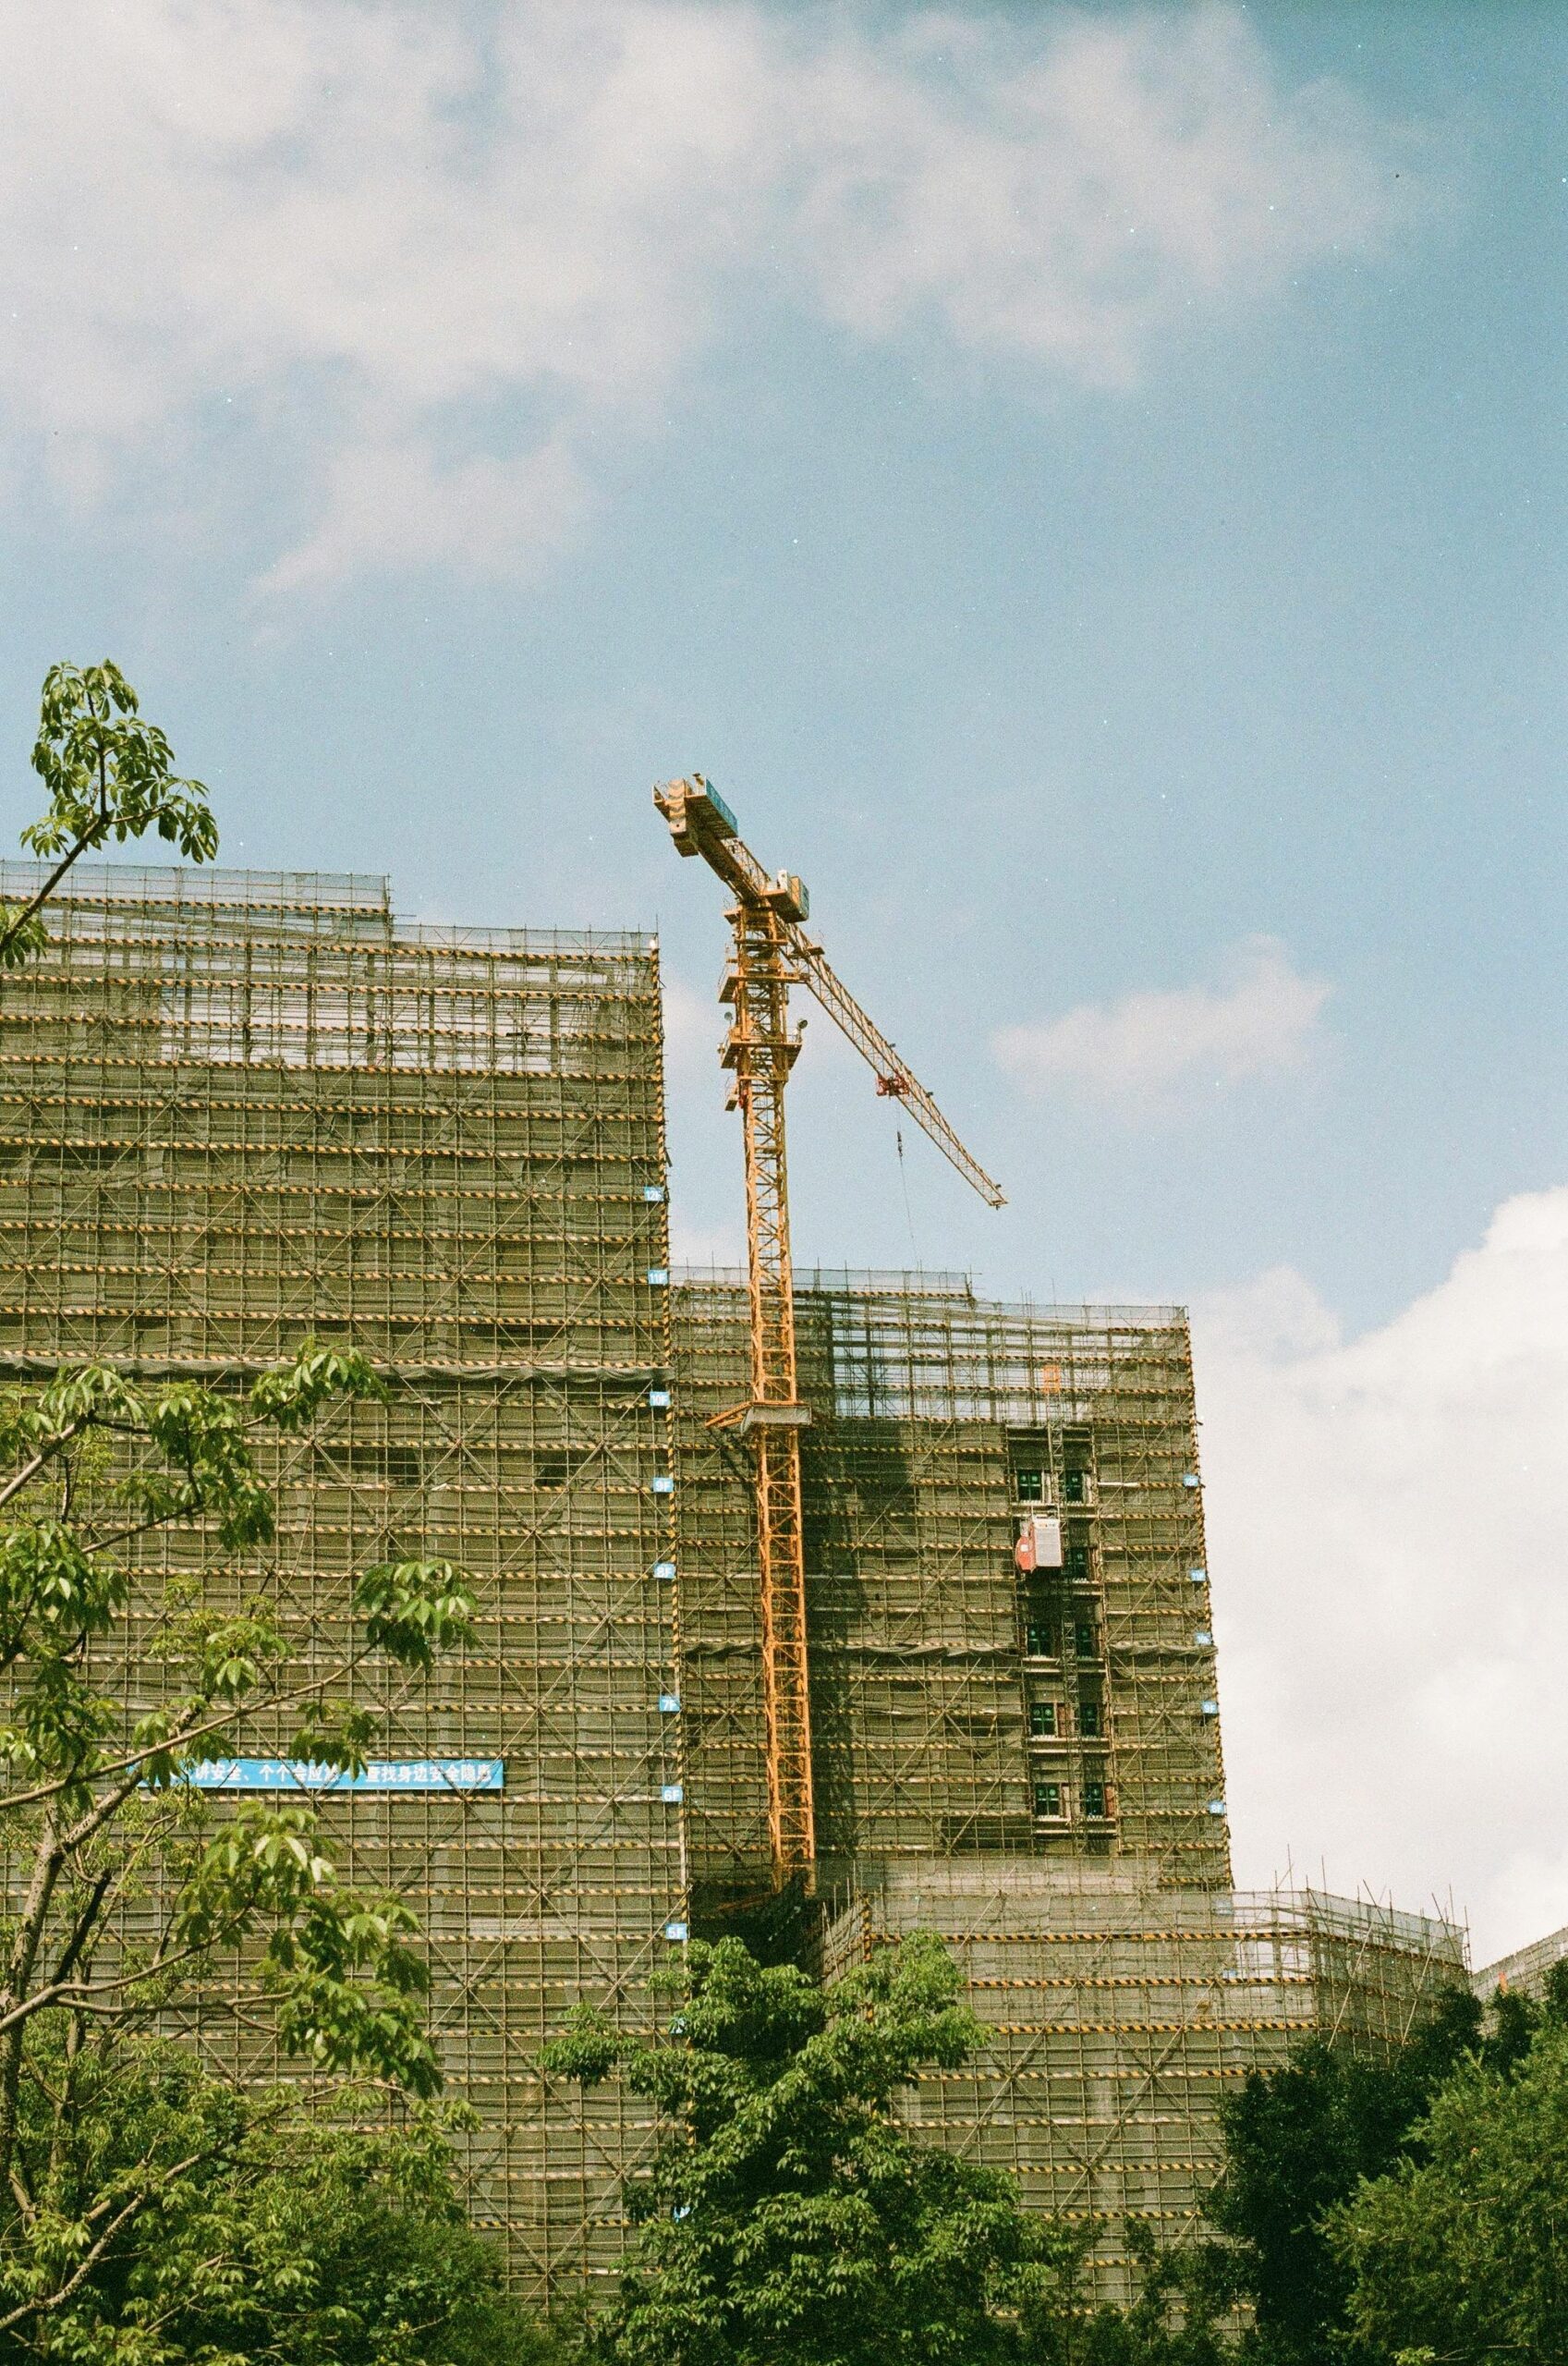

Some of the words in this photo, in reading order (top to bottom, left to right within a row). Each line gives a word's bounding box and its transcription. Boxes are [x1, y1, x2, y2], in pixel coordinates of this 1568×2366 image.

[649, 1273, 667, 1283] 11F
[650, 1395, 669, 1406] 10F
[655, 1480, 672, 1492] 9F
[657, 1566, 675, 1578] 8F
[662, 1699, 677, 1711] 7F
[1204, 1703, 1216, 1714] 9F
[663, 1789, 680, 1801] 6F
[668, 1926, 686, 1939] 5F
